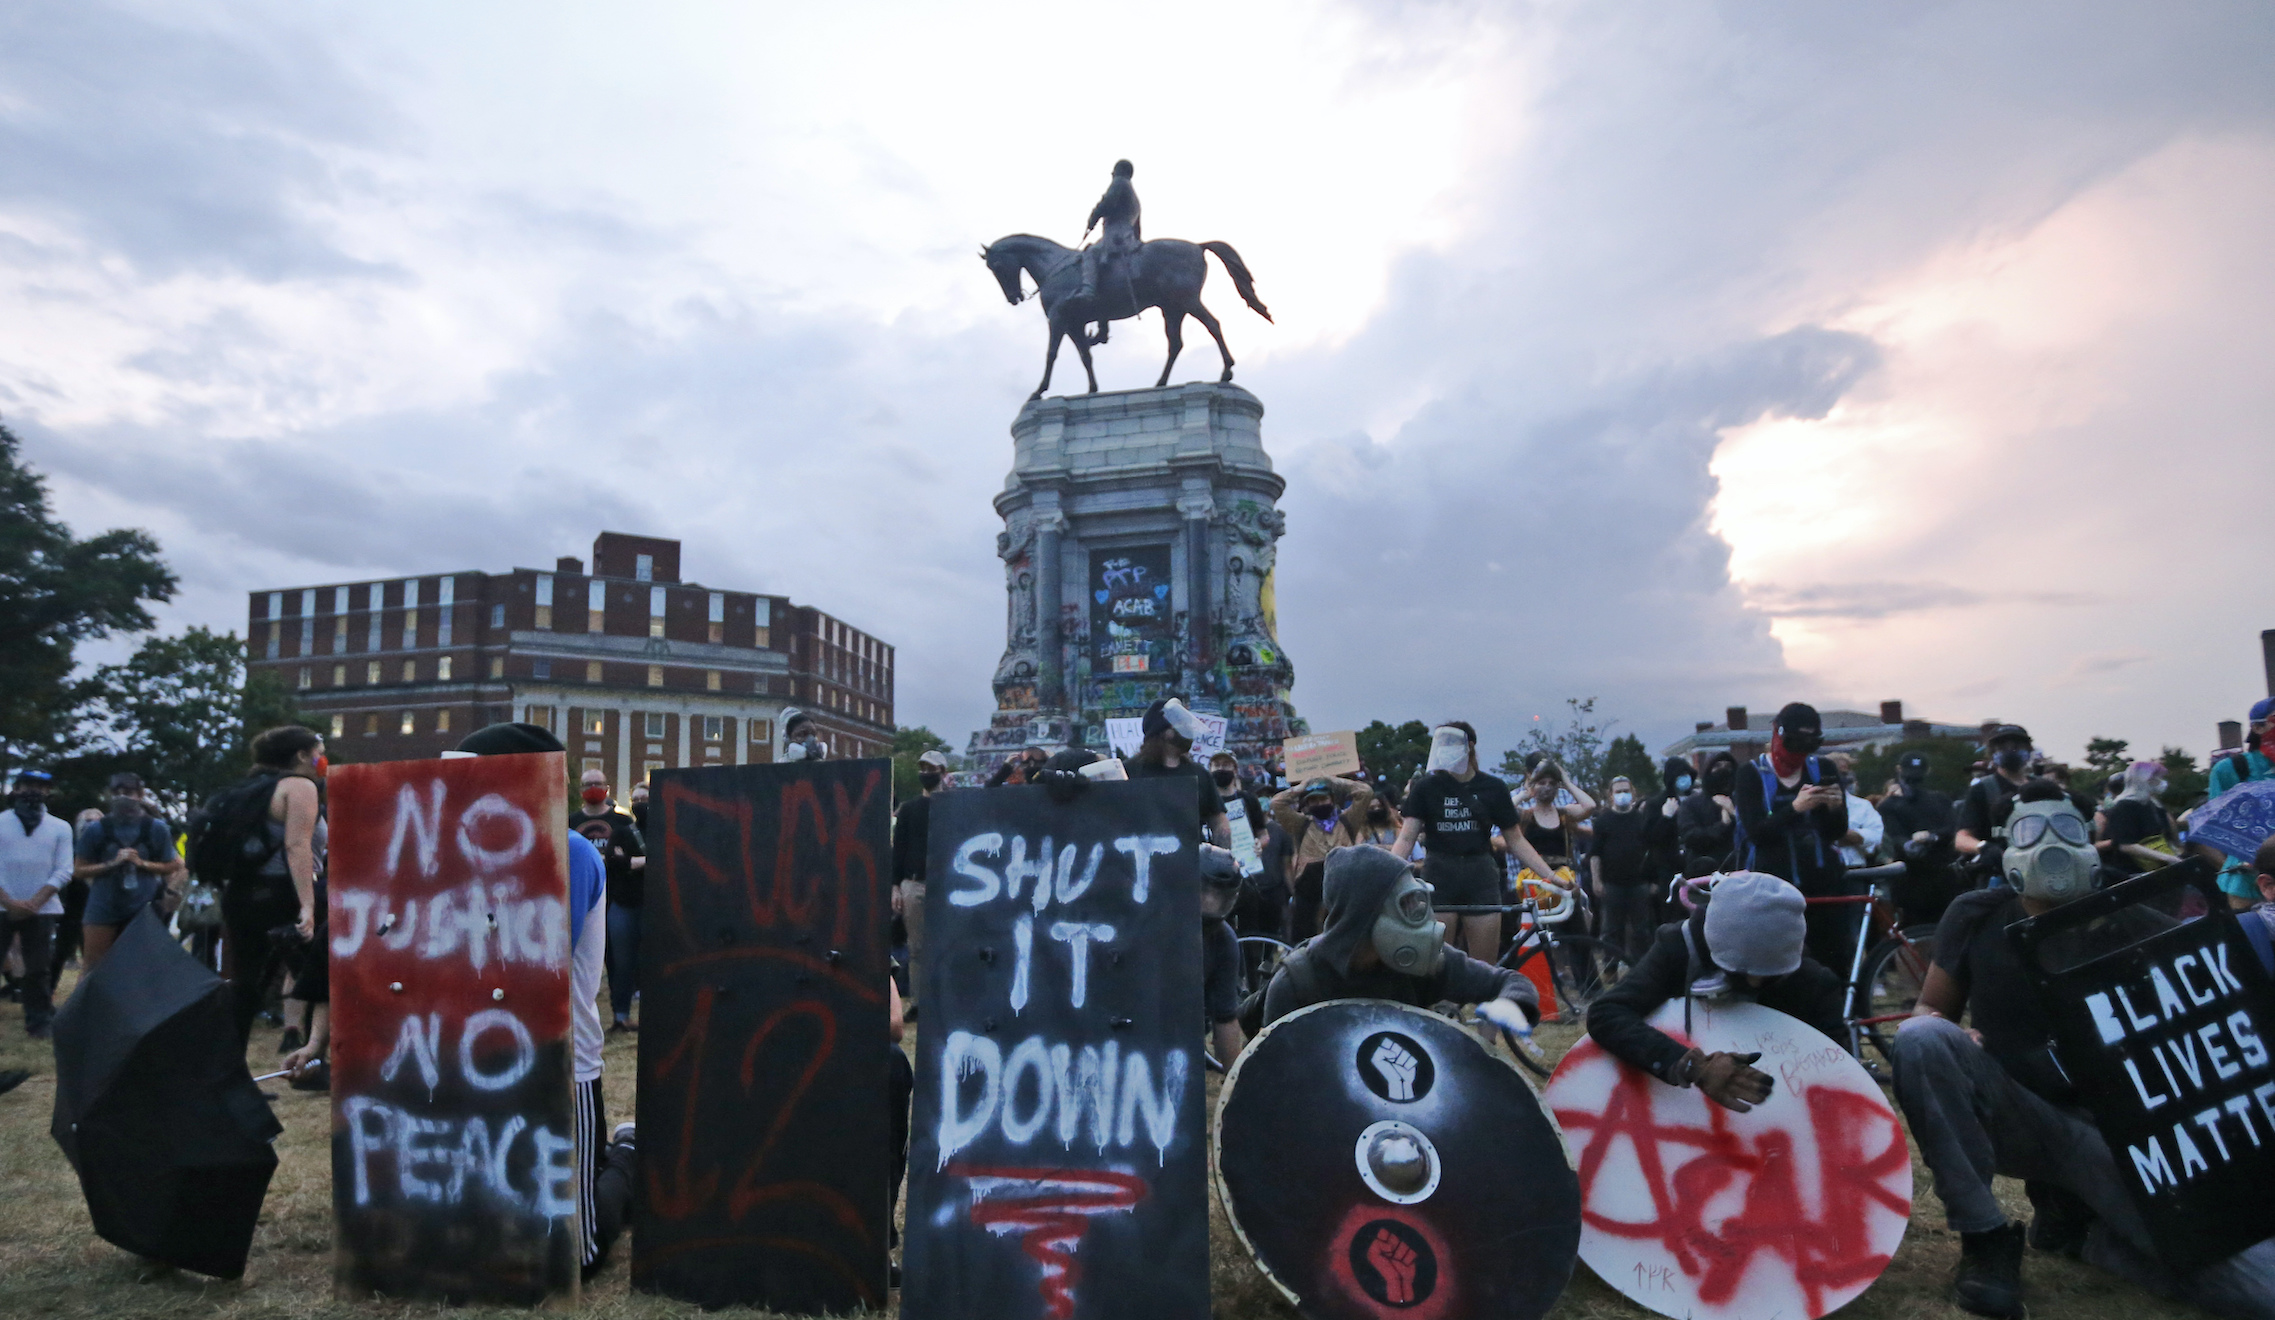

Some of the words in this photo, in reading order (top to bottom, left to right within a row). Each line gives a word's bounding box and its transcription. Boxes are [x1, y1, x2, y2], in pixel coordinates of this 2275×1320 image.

[1112, 598, 1155, 615] ACAB
[387, 778, 536, 877] NO
[661, 770, 883, 960] FUCK
[948, 831, 1181, 916] SHUT
[1009, 912, 1116, 1013] IT
[2085, 942, 2243, 1045] BLACK
[381, 1009, 535, 1095] NO
[936, 1030, 1190, 1165] DOWN
[2123, 1010, 2270, 1110] LIVES
[342, 1096, 577, 1225] PEACE
[654, 984, 871, 1245] 12
[2127, 1082, 2275, 1195] MATTE
